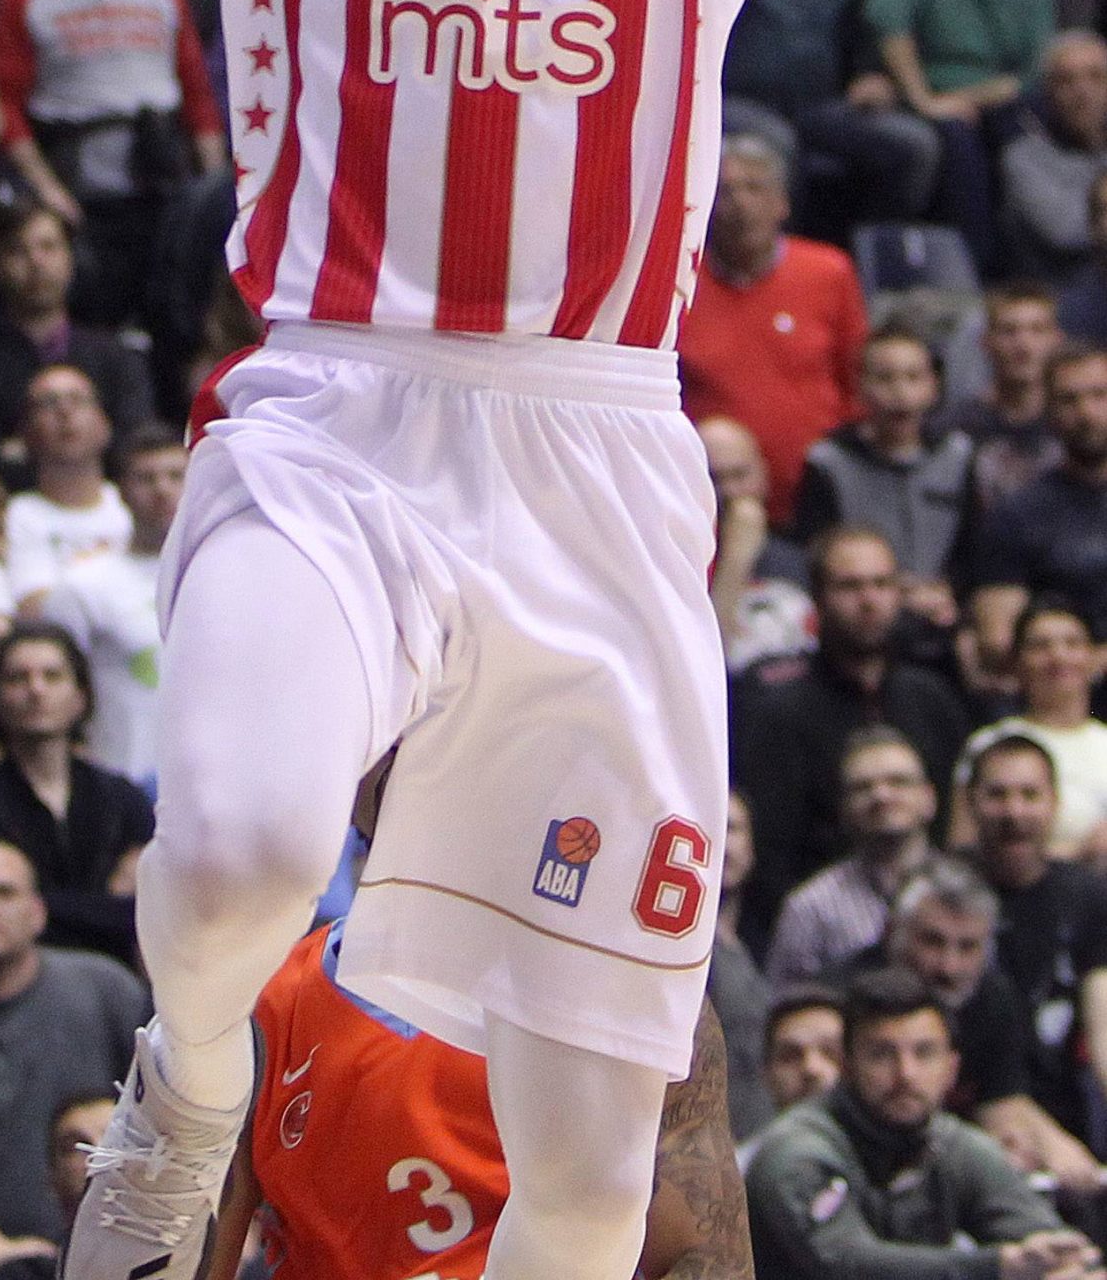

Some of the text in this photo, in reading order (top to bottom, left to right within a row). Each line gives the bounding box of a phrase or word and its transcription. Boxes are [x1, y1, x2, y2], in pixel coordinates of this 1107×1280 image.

[536, 858, 580, 901] ABA
[631, 814, 711, 940] 6
[386, 1156, 475, 1255] 3
